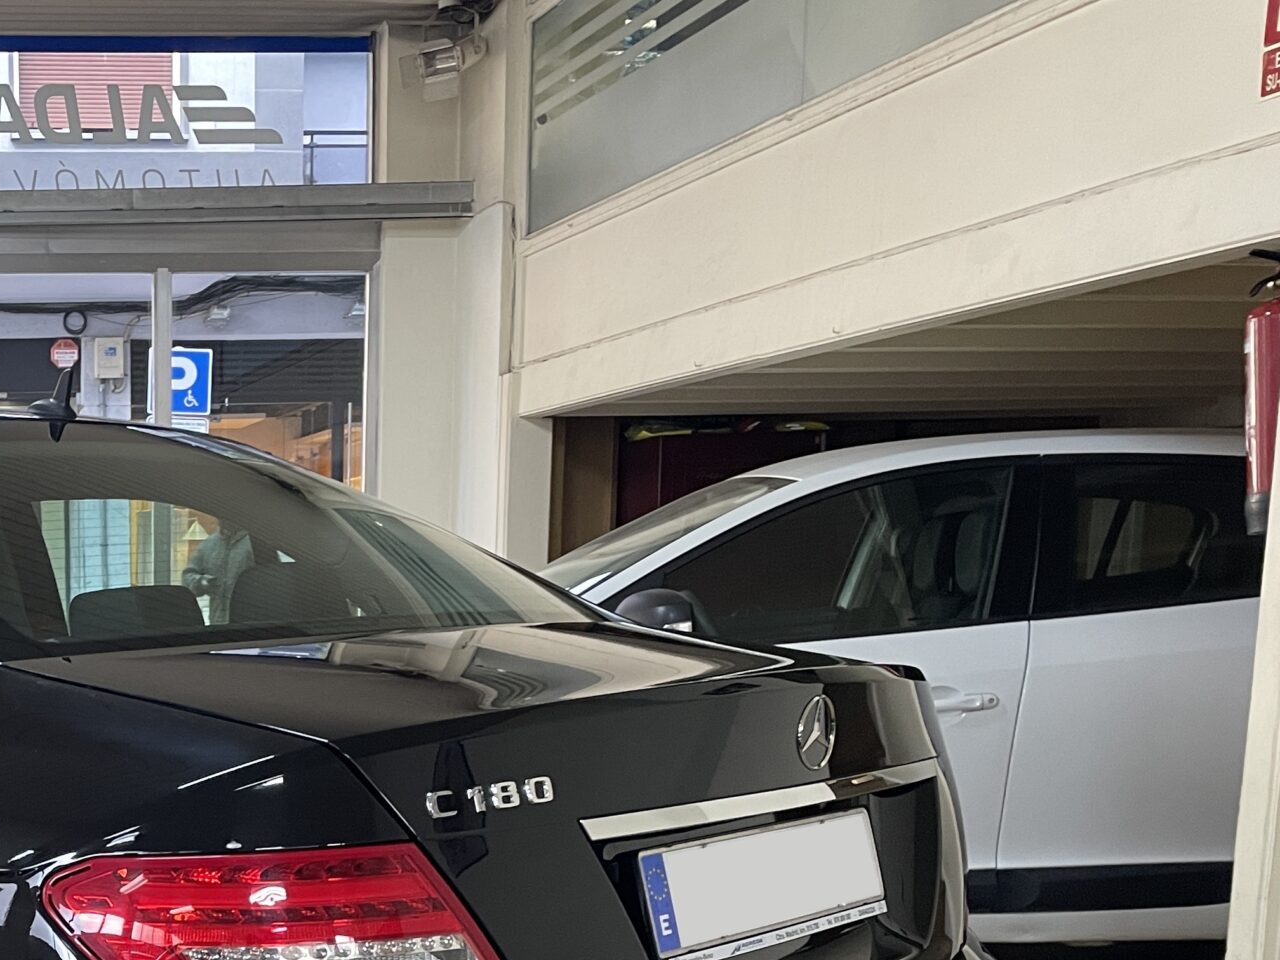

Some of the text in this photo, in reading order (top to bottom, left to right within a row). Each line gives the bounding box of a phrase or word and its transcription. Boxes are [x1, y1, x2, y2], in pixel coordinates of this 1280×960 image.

[426, 776, 555, 819] C 180
[659, 913, 672, 936] E
